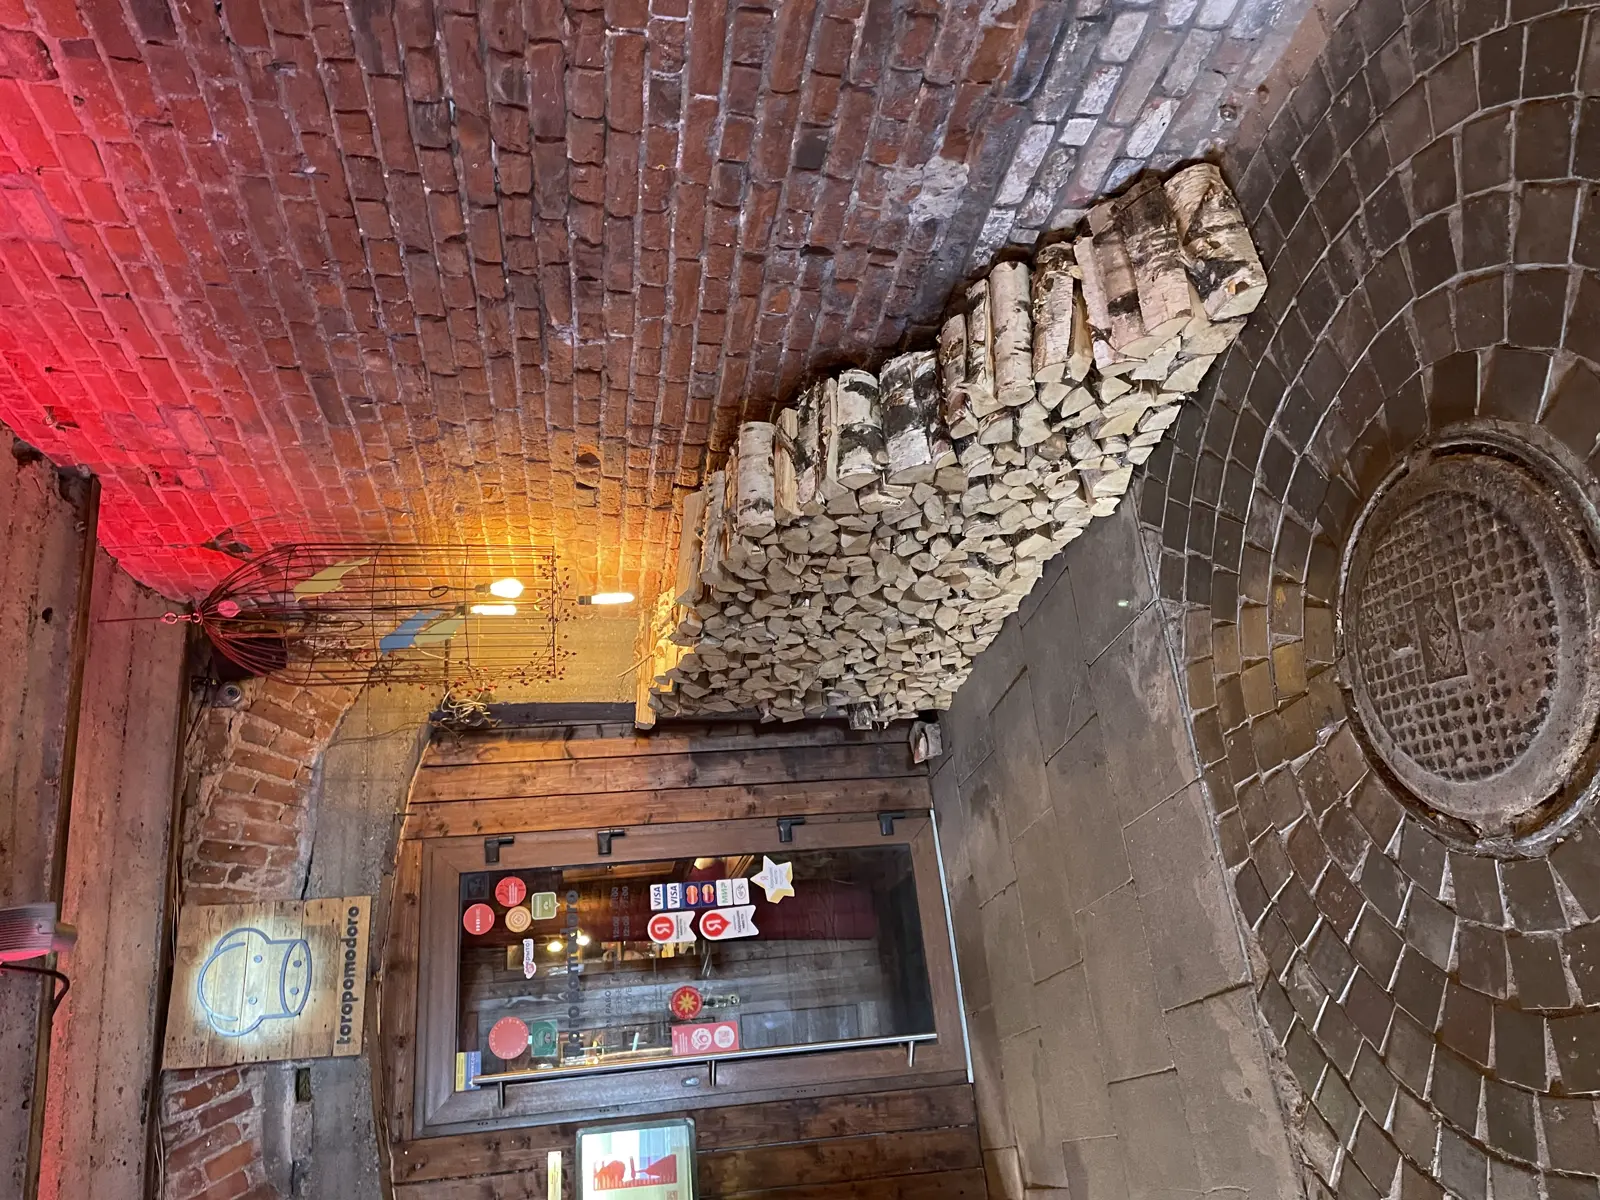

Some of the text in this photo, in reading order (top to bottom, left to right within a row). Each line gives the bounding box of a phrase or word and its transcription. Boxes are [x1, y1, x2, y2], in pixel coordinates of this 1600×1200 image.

[653, 886, 662, 907] VISA
[669, 885, 678, 905] VISA
[720, 881, 729, 904] МИР
[336, 905, 360, 1045] toropomodoro
[560, 890, 585, 1057] oropomodoro
